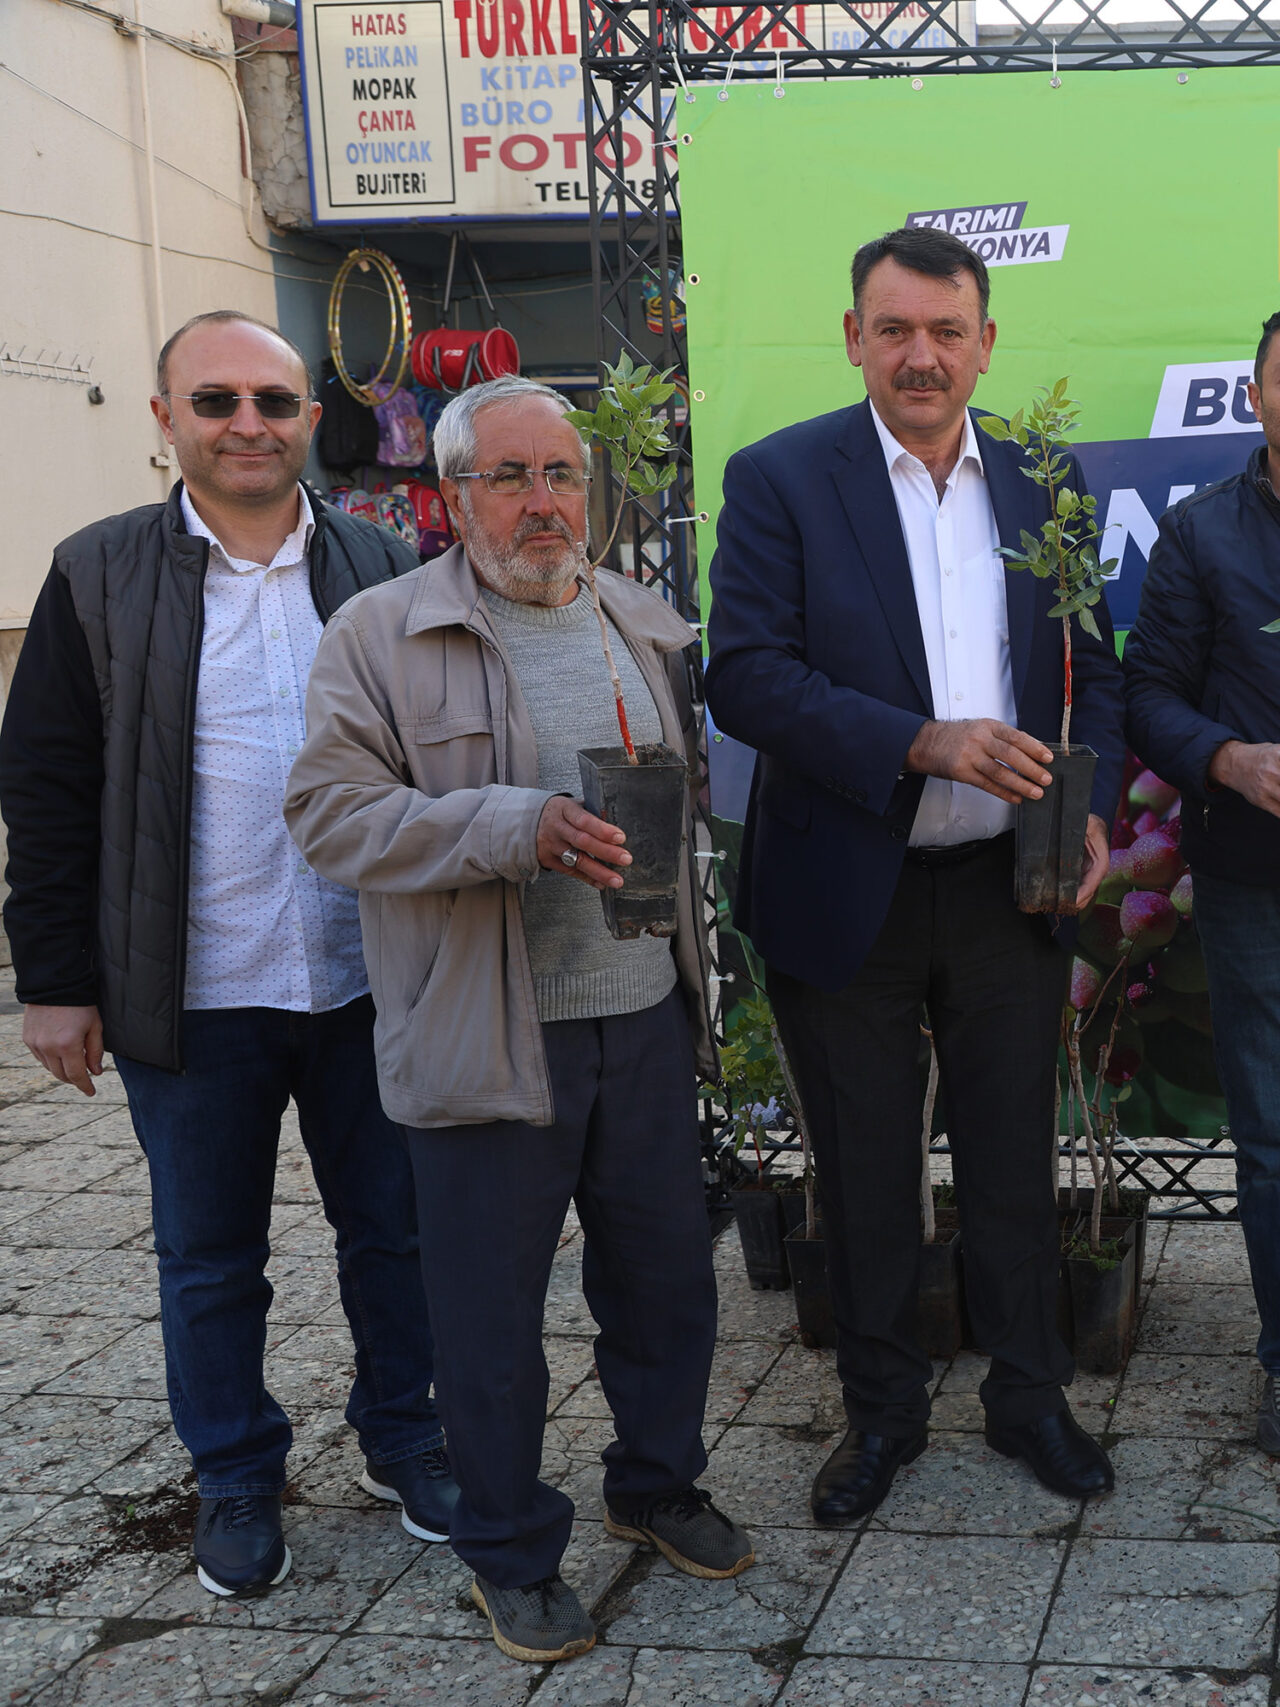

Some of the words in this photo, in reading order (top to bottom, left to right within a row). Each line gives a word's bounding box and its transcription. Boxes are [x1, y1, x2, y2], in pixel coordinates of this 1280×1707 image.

[351, 13, 407, 36] HATAS
[352, 78, 417, 101] MOPAK
[358, 109, 416, 138] ÇANTA
[461, 99, 553, 127] BÜRO
[346, 140, 433, 165] OYUNCAK
